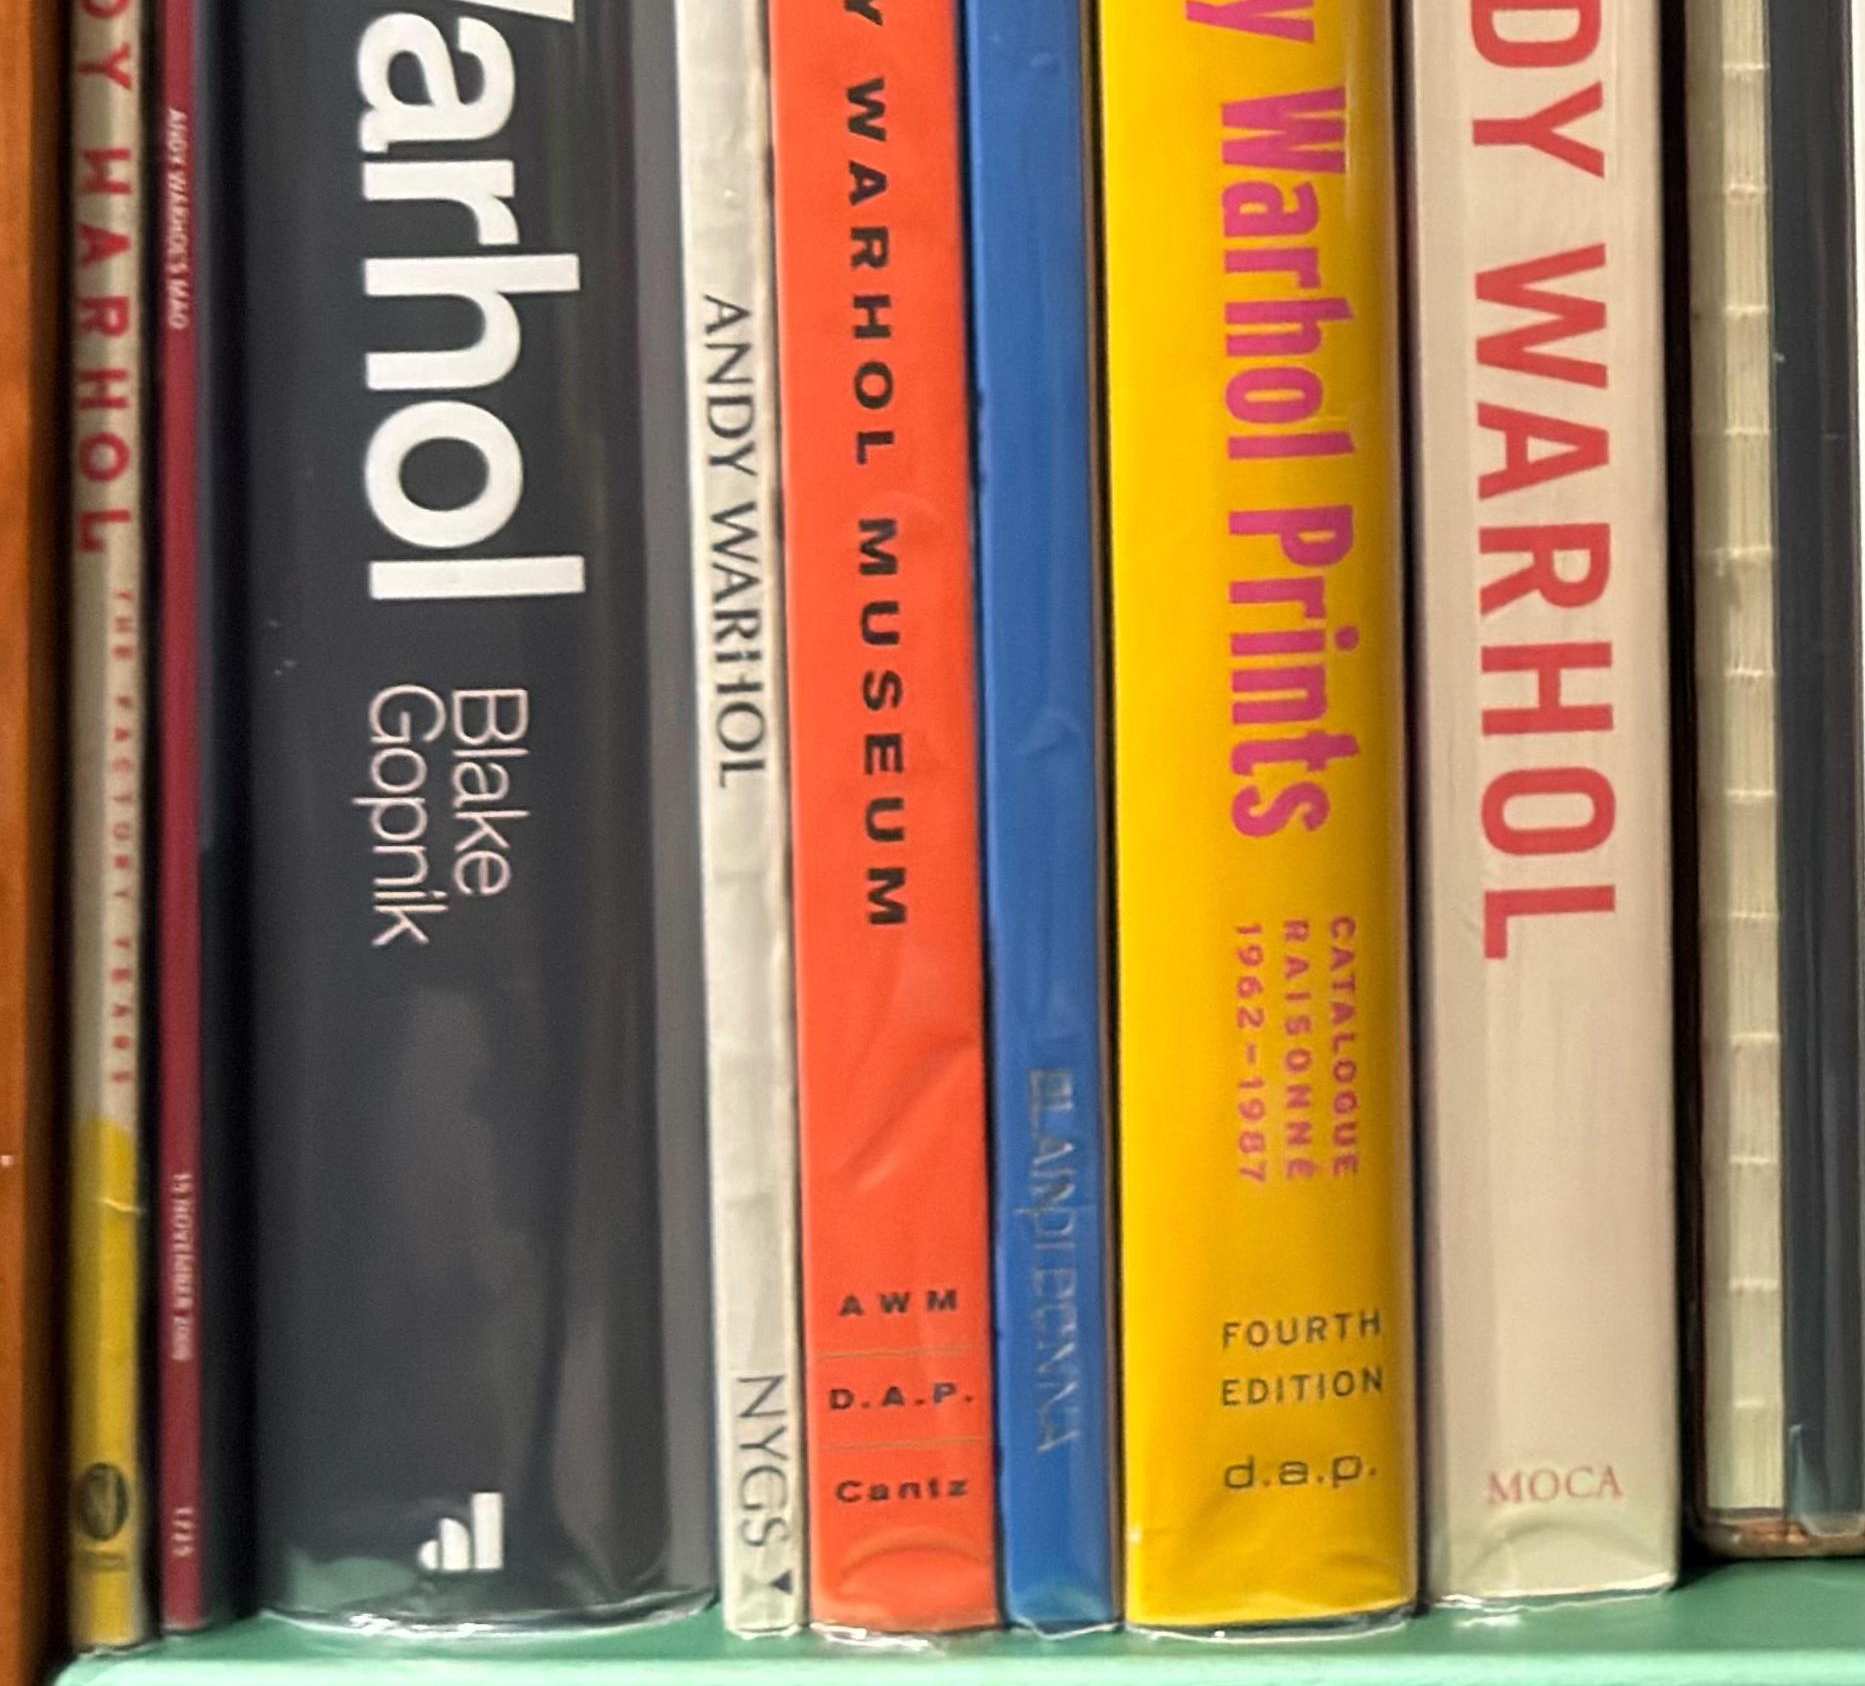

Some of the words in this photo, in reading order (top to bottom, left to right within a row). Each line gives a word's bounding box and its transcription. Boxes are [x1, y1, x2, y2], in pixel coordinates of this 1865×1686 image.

[165, 106, 190, 165] ANDY
[74, 146, 132, 556] WARHOL
[165, 279, 191, 331] MAO
[844, 74, 897, 466] WARHOL
[1219, 86, 1357, 461] Warhol
[701, 292, 759, 478] ANDY
[709, 499, 768, 790] WARHOL
[1229, 503, 1361, 839] Prints
[1473, 241, 1618, 963] WARHOL
[350, 683, 451, 948] Gopnik
[446, 687, 532, 898] Blake
[856, 517, 910, 928] MUSEUM
[1328, 916, 1359, 1178] CATALOGUE
[1219, 1311, 1383, 1354] FOURTH
[1219, 1368, 1384, 1410] EDITION
[737, 1372, 792, 1552] NYGS
[834, 1477, 970, 1506] Cantz
[1221, 1454, 1379, 1492] d.a.p.
[1486, 1464, 1625, 1507] MOCA
